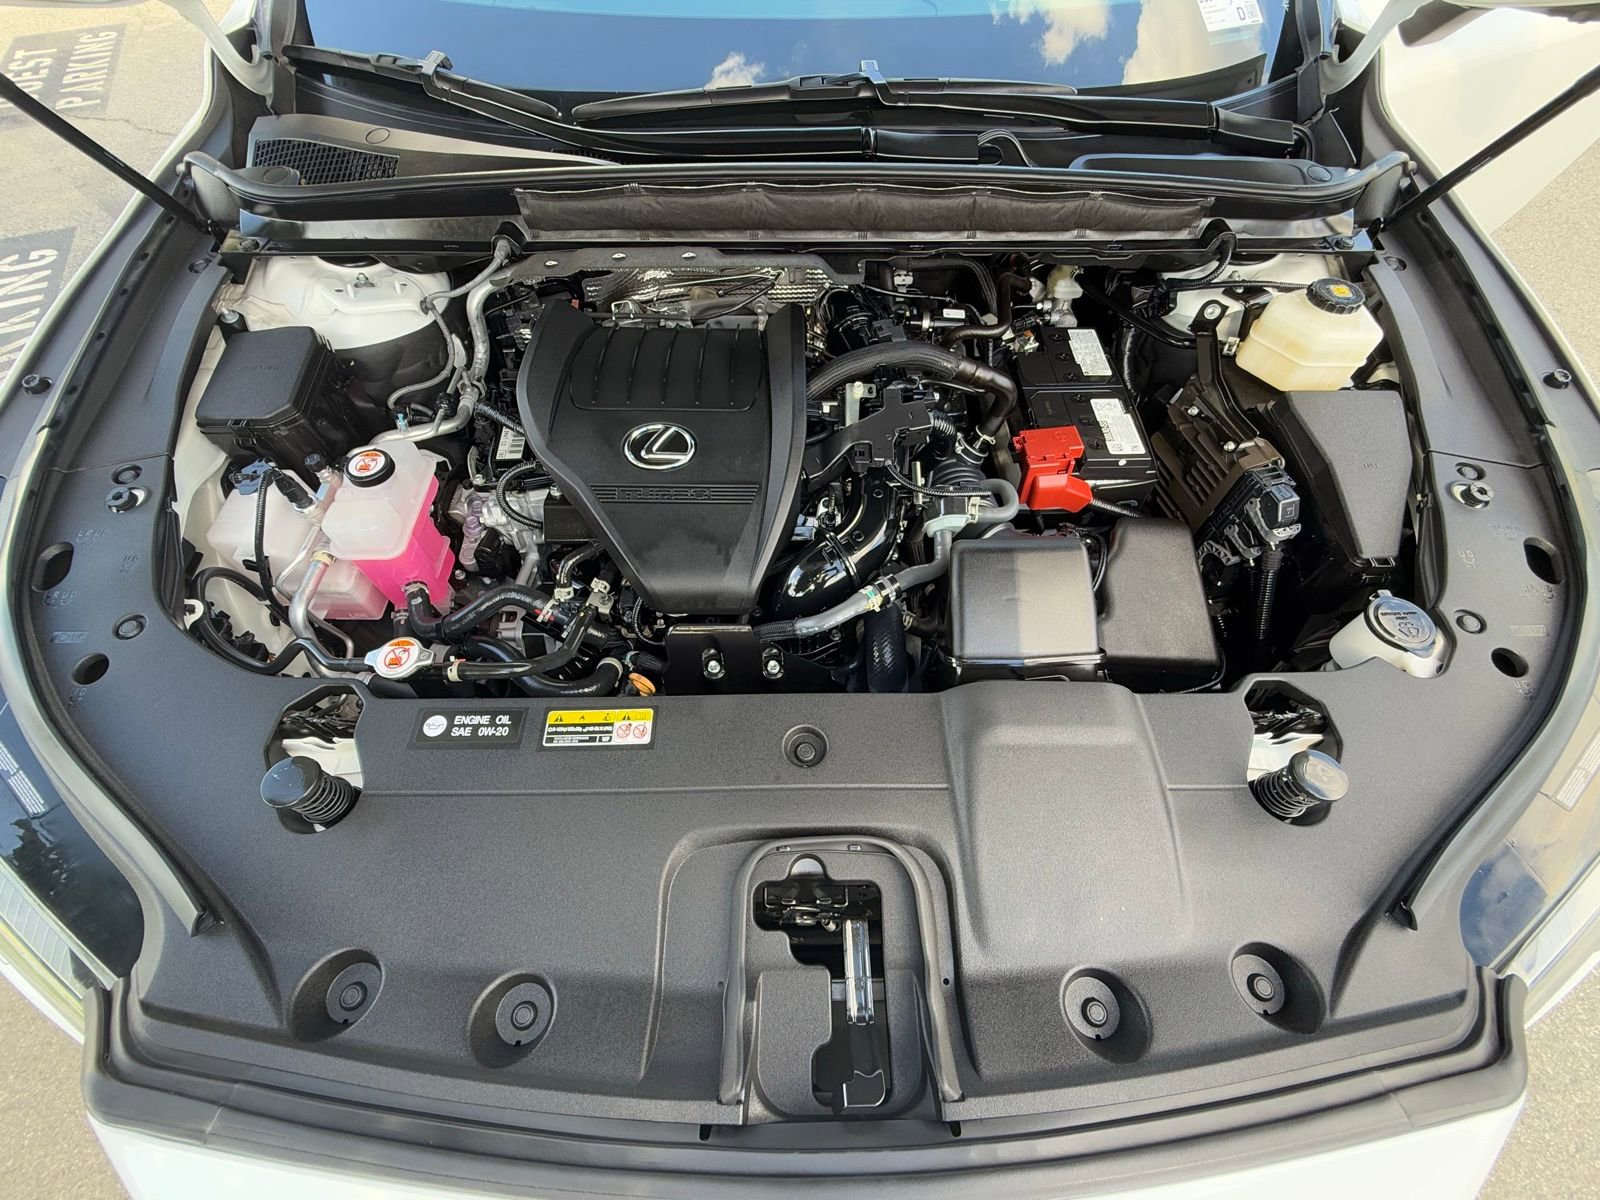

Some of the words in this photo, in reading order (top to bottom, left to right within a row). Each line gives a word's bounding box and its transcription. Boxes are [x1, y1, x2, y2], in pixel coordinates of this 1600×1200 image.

[55, 31, 118, 110] PARKING
[0, 248, 59, 382] KING
[450, 726, 473, 737] SAE
[477, 726, 510, 737] 0W-20
[453, 714, 491, 725] ENGINE
[495, 714, 512, 725] OIL
